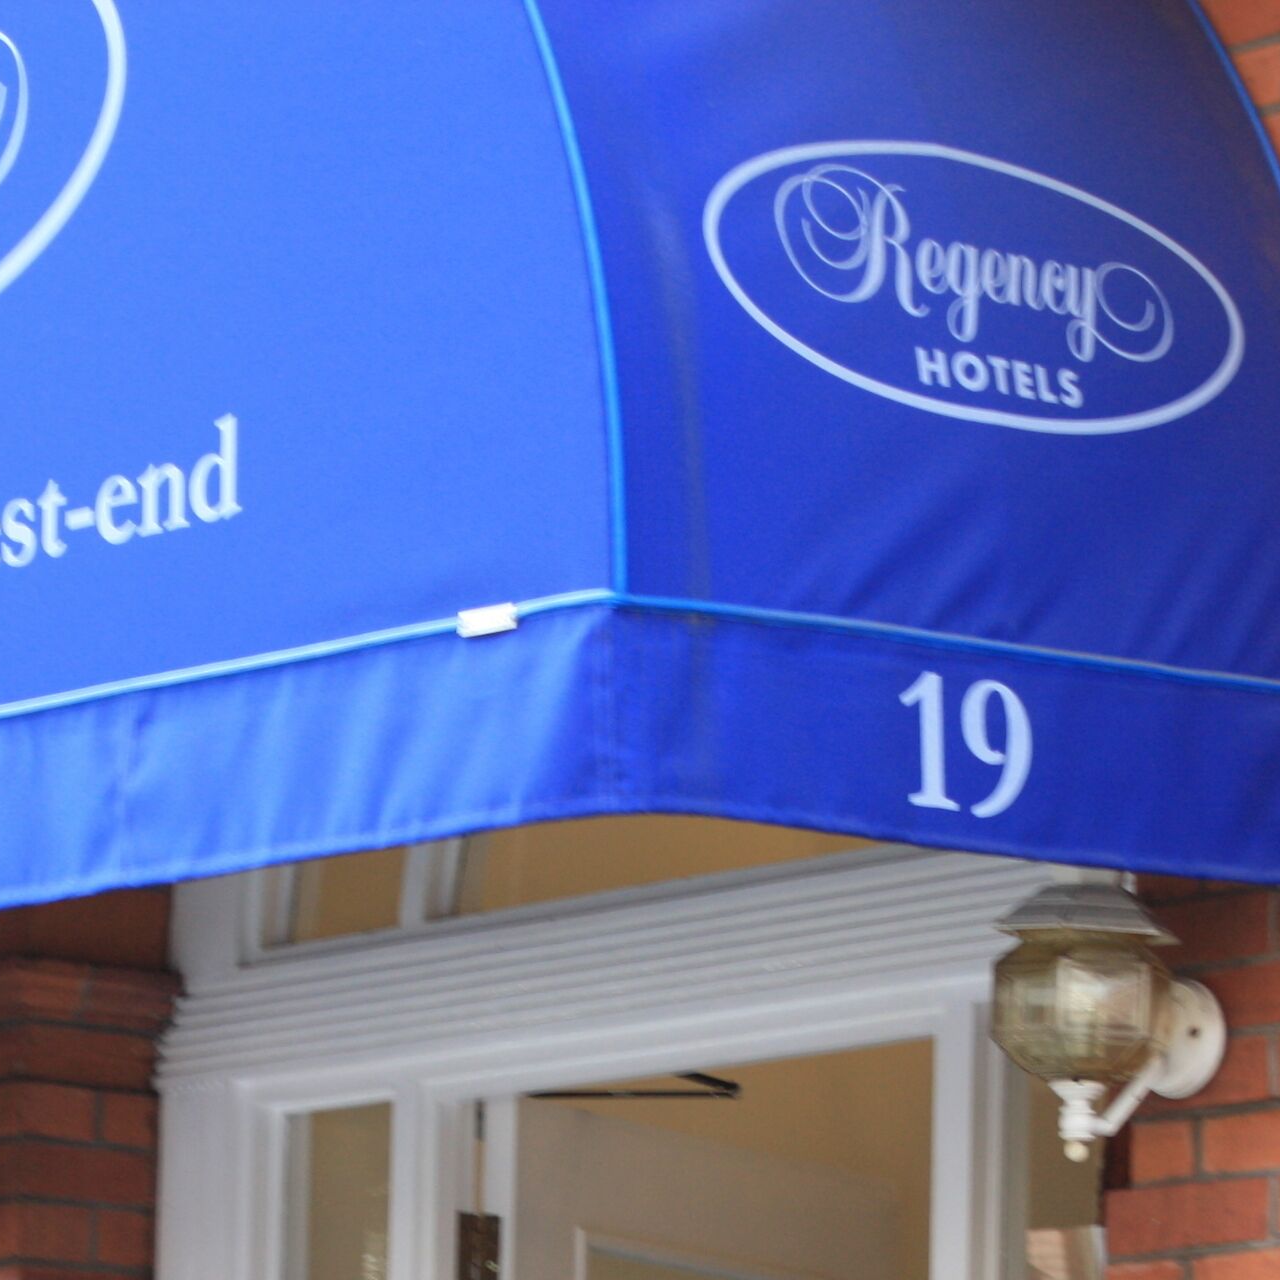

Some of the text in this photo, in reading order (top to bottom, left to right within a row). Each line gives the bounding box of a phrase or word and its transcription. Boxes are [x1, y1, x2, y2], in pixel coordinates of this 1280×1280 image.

[773, 162, 1175, 362] Regency
[914, 346, 1085, 409] HOTELS
[898, 669, 1034, 819] 19
